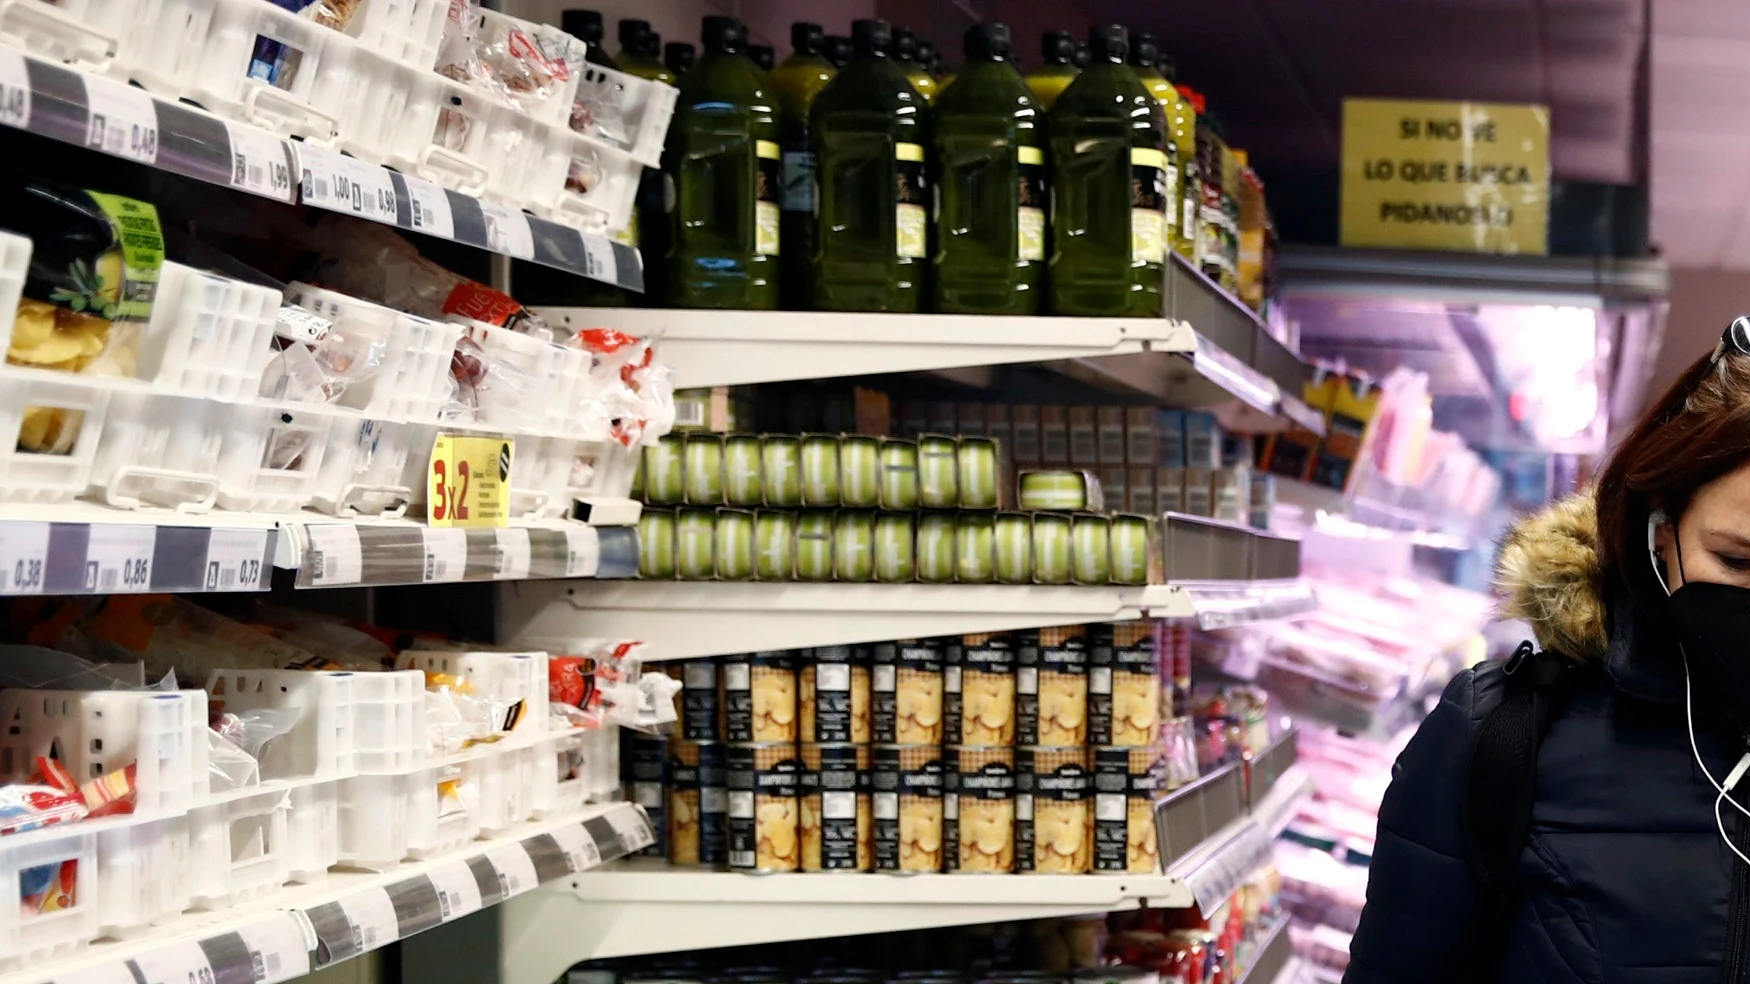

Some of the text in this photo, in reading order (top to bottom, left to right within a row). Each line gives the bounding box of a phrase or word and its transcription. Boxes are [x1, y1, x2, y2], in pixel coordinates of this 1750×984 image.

[1400, 117, 1420, 139] SI
[1426, 119, 1463, 142] NO
[1363, 159, 1394, 181] LO
[1400, 160, 1448, 185] QUE
[332, 174, 350, 200] 1,00
[378, 187, 396, 215] 0,98
